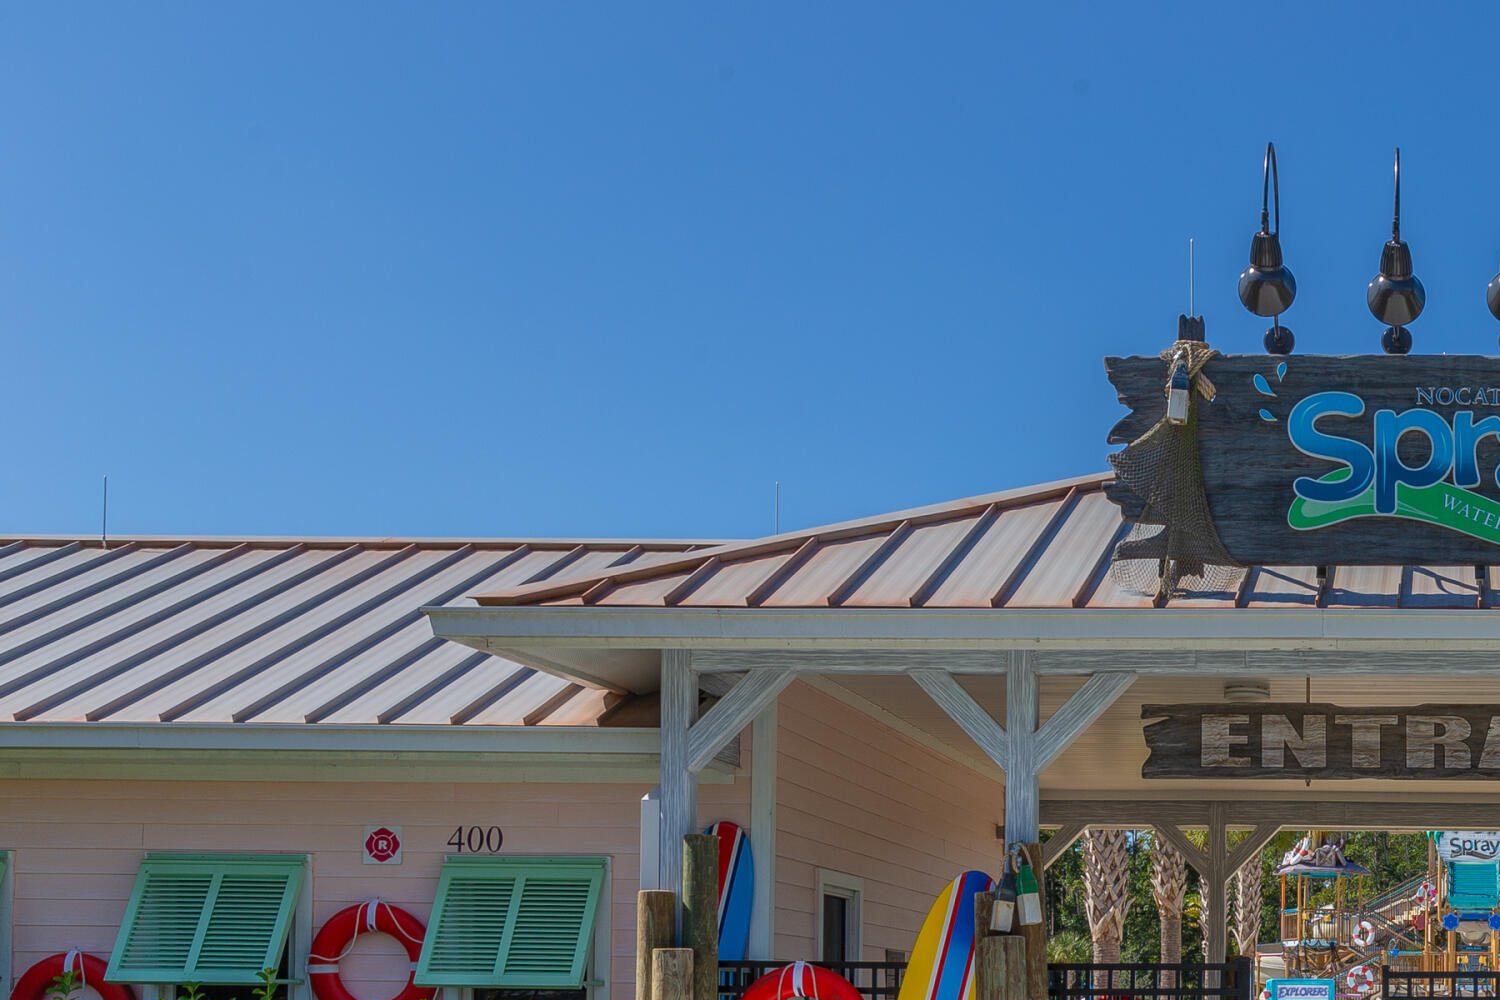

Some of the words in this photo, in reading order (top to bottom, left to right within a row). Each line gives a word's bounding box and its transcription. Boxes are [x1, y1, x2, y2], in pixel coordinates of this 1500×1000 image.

[377, 840, 388, 850] R
[447, 825, 503, 853] 400
[1449, 837, 1500, 856] Spray
[1279, 987, 1328, 999] EXPLORERS
